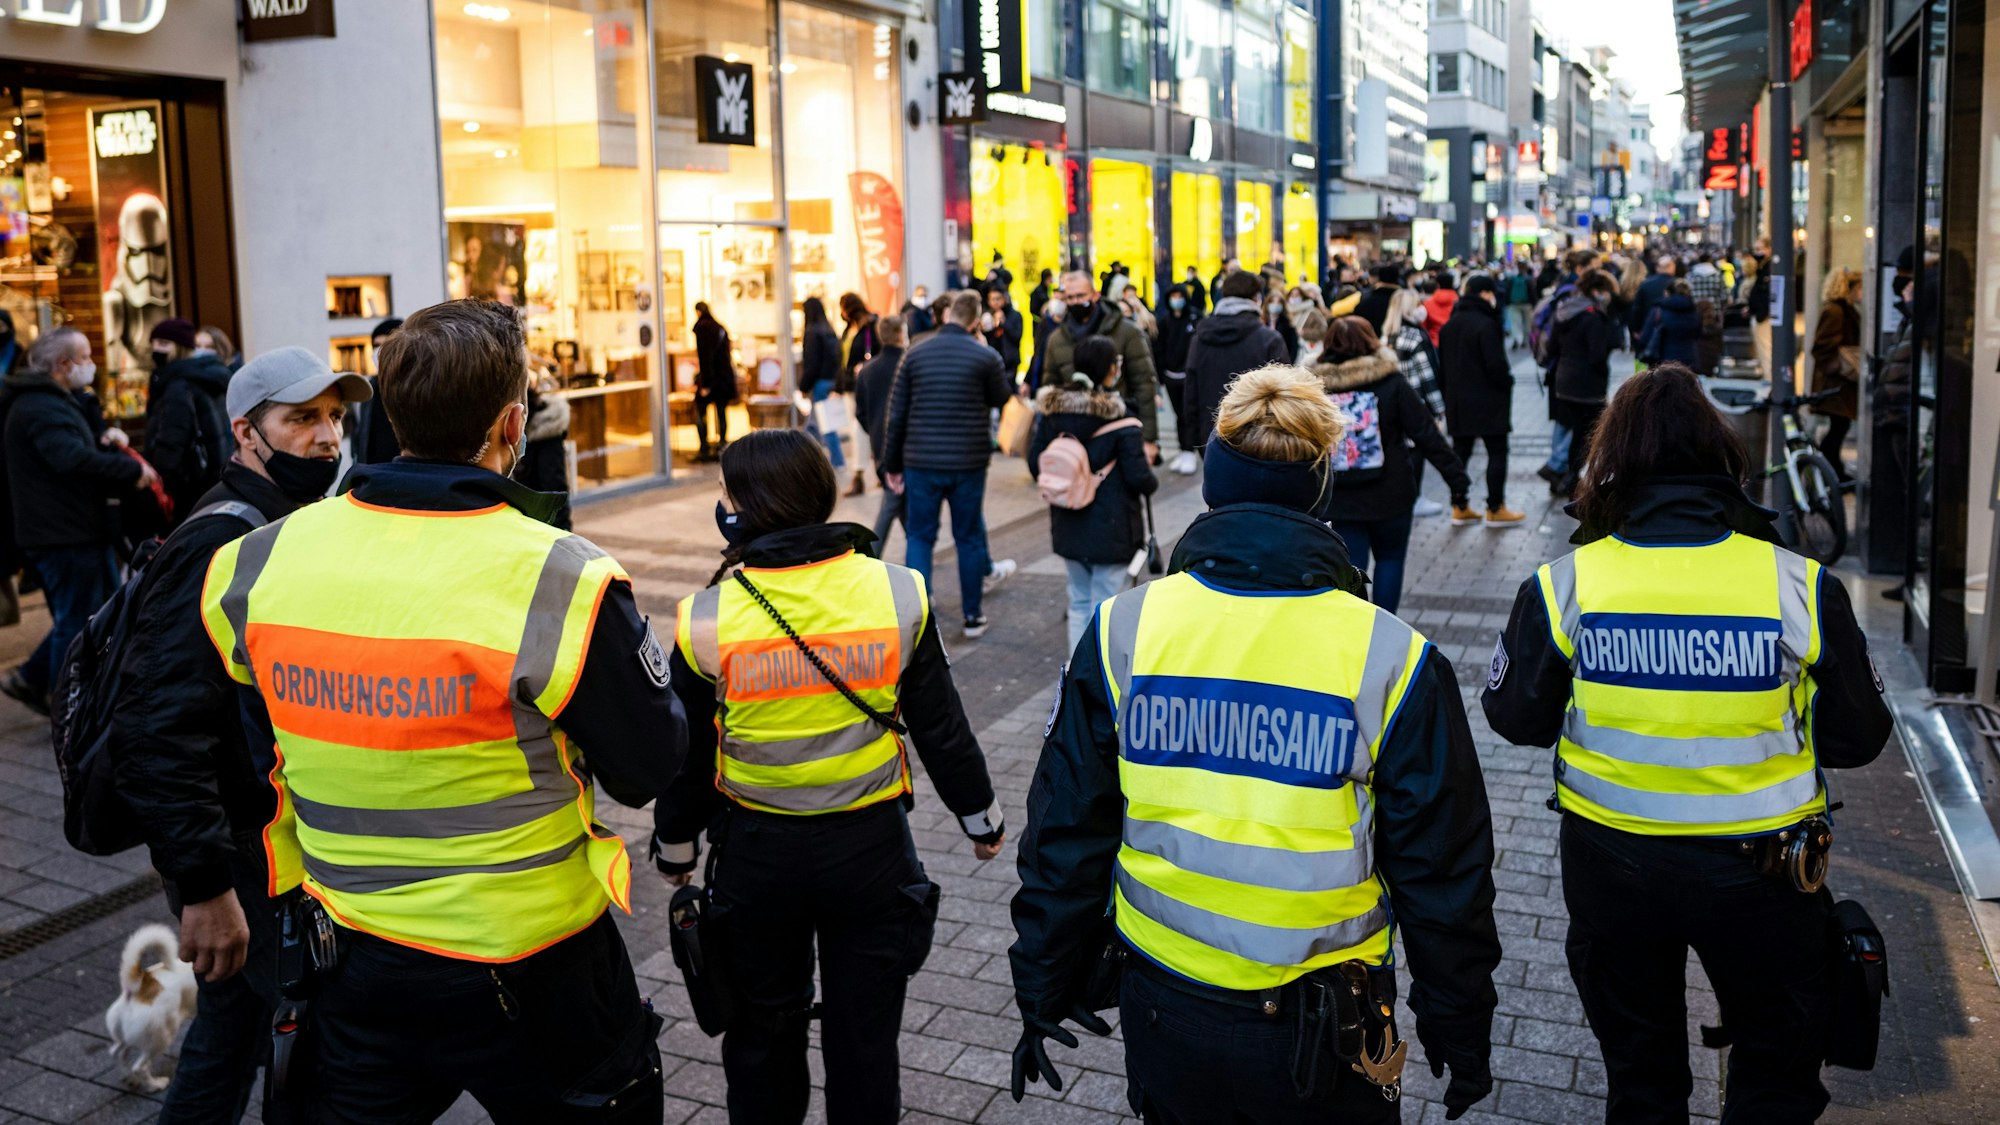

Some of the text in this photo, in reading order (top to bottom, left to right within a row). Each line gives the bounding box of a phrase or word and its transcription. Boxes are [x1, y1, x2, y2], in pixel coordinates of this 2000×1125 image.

[248, 0, 308, 19] WALD
[731, 642, 886, 692] ORDNUNGSAMT
[1580, 627, 1779, 677] ORDNUNGSAMT
[272, 661, 477, 719] ORDNUNGSAMT
[1129, 693, 1354, 776] ORDNUNGSAMT
